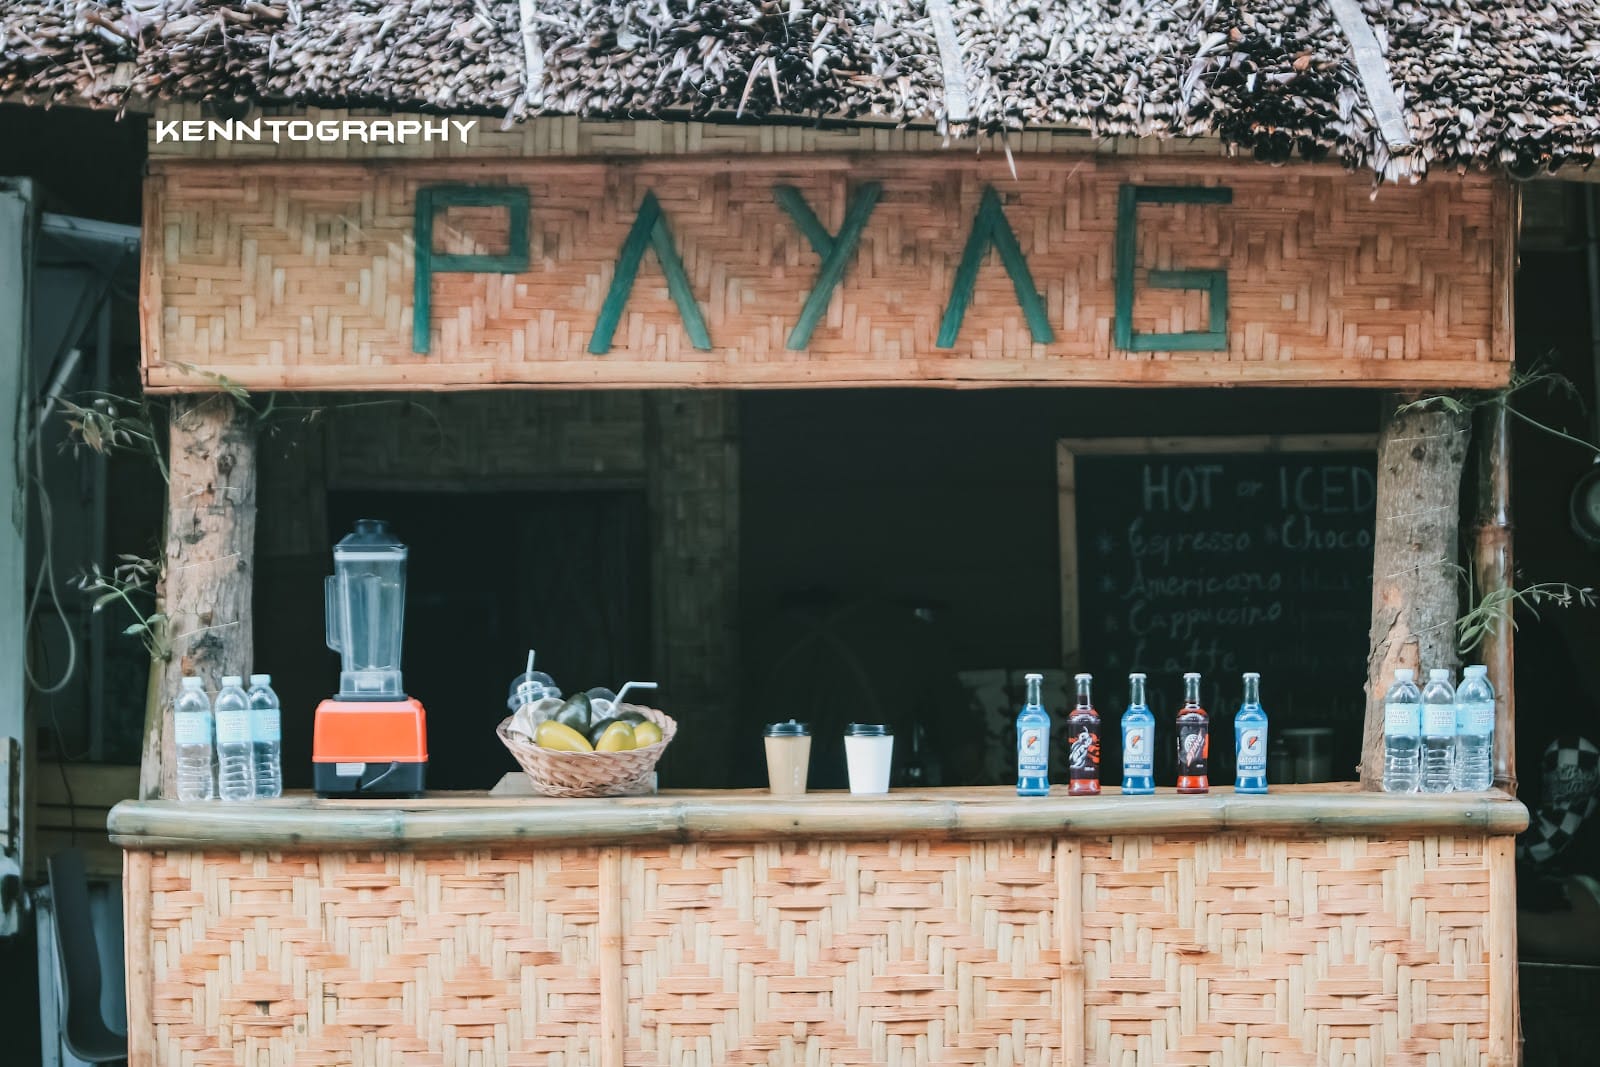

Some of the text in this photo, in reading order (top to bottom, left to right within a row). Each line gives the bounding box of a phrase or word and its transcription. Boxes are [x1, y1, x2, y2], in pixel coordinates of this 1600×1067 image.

[413, 181, 1233, 355] PAYAG
[1143, 464, 1377, 513] HOT or ICED
[1128, 516, 1252, 567] Espresso
[1120, 559, 1282, 600] Americano
[1130, 637, 1240, 672] Latte
